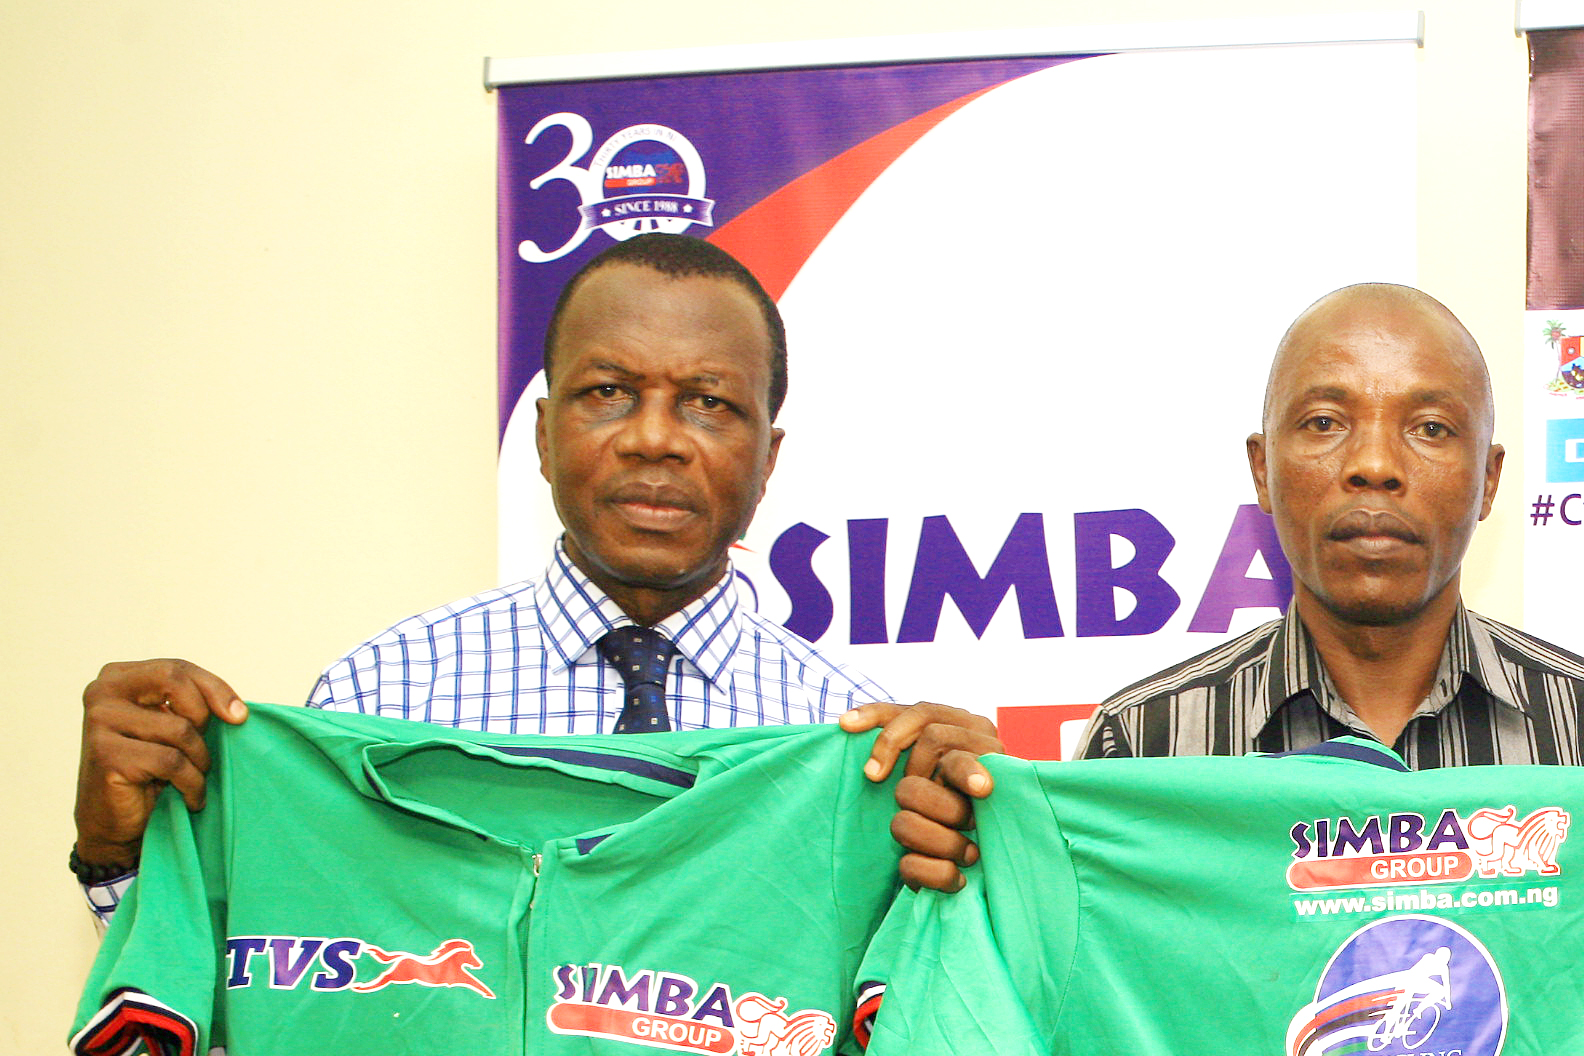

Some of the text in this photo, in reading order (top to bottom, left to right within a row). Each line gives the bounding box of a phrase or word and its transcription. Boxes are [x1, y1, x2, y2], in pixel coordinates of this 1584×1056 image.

[605, 164, 656, 179] SIMBA
[614, 200, 679, 216] SINCE 1988
[769, 504, 1293, 645] SIMBA
[1291, 810, 1470, 858] SIMBA
[1370, 854, 1460, 880] GROUP
[1294, 884, 1559, 917] www.simba.com.ng
[225, 938, 361, 991] TVS
[554, 963, 736, 1028] SIMBA
[632, 1016, 722, 1048] GROUP
